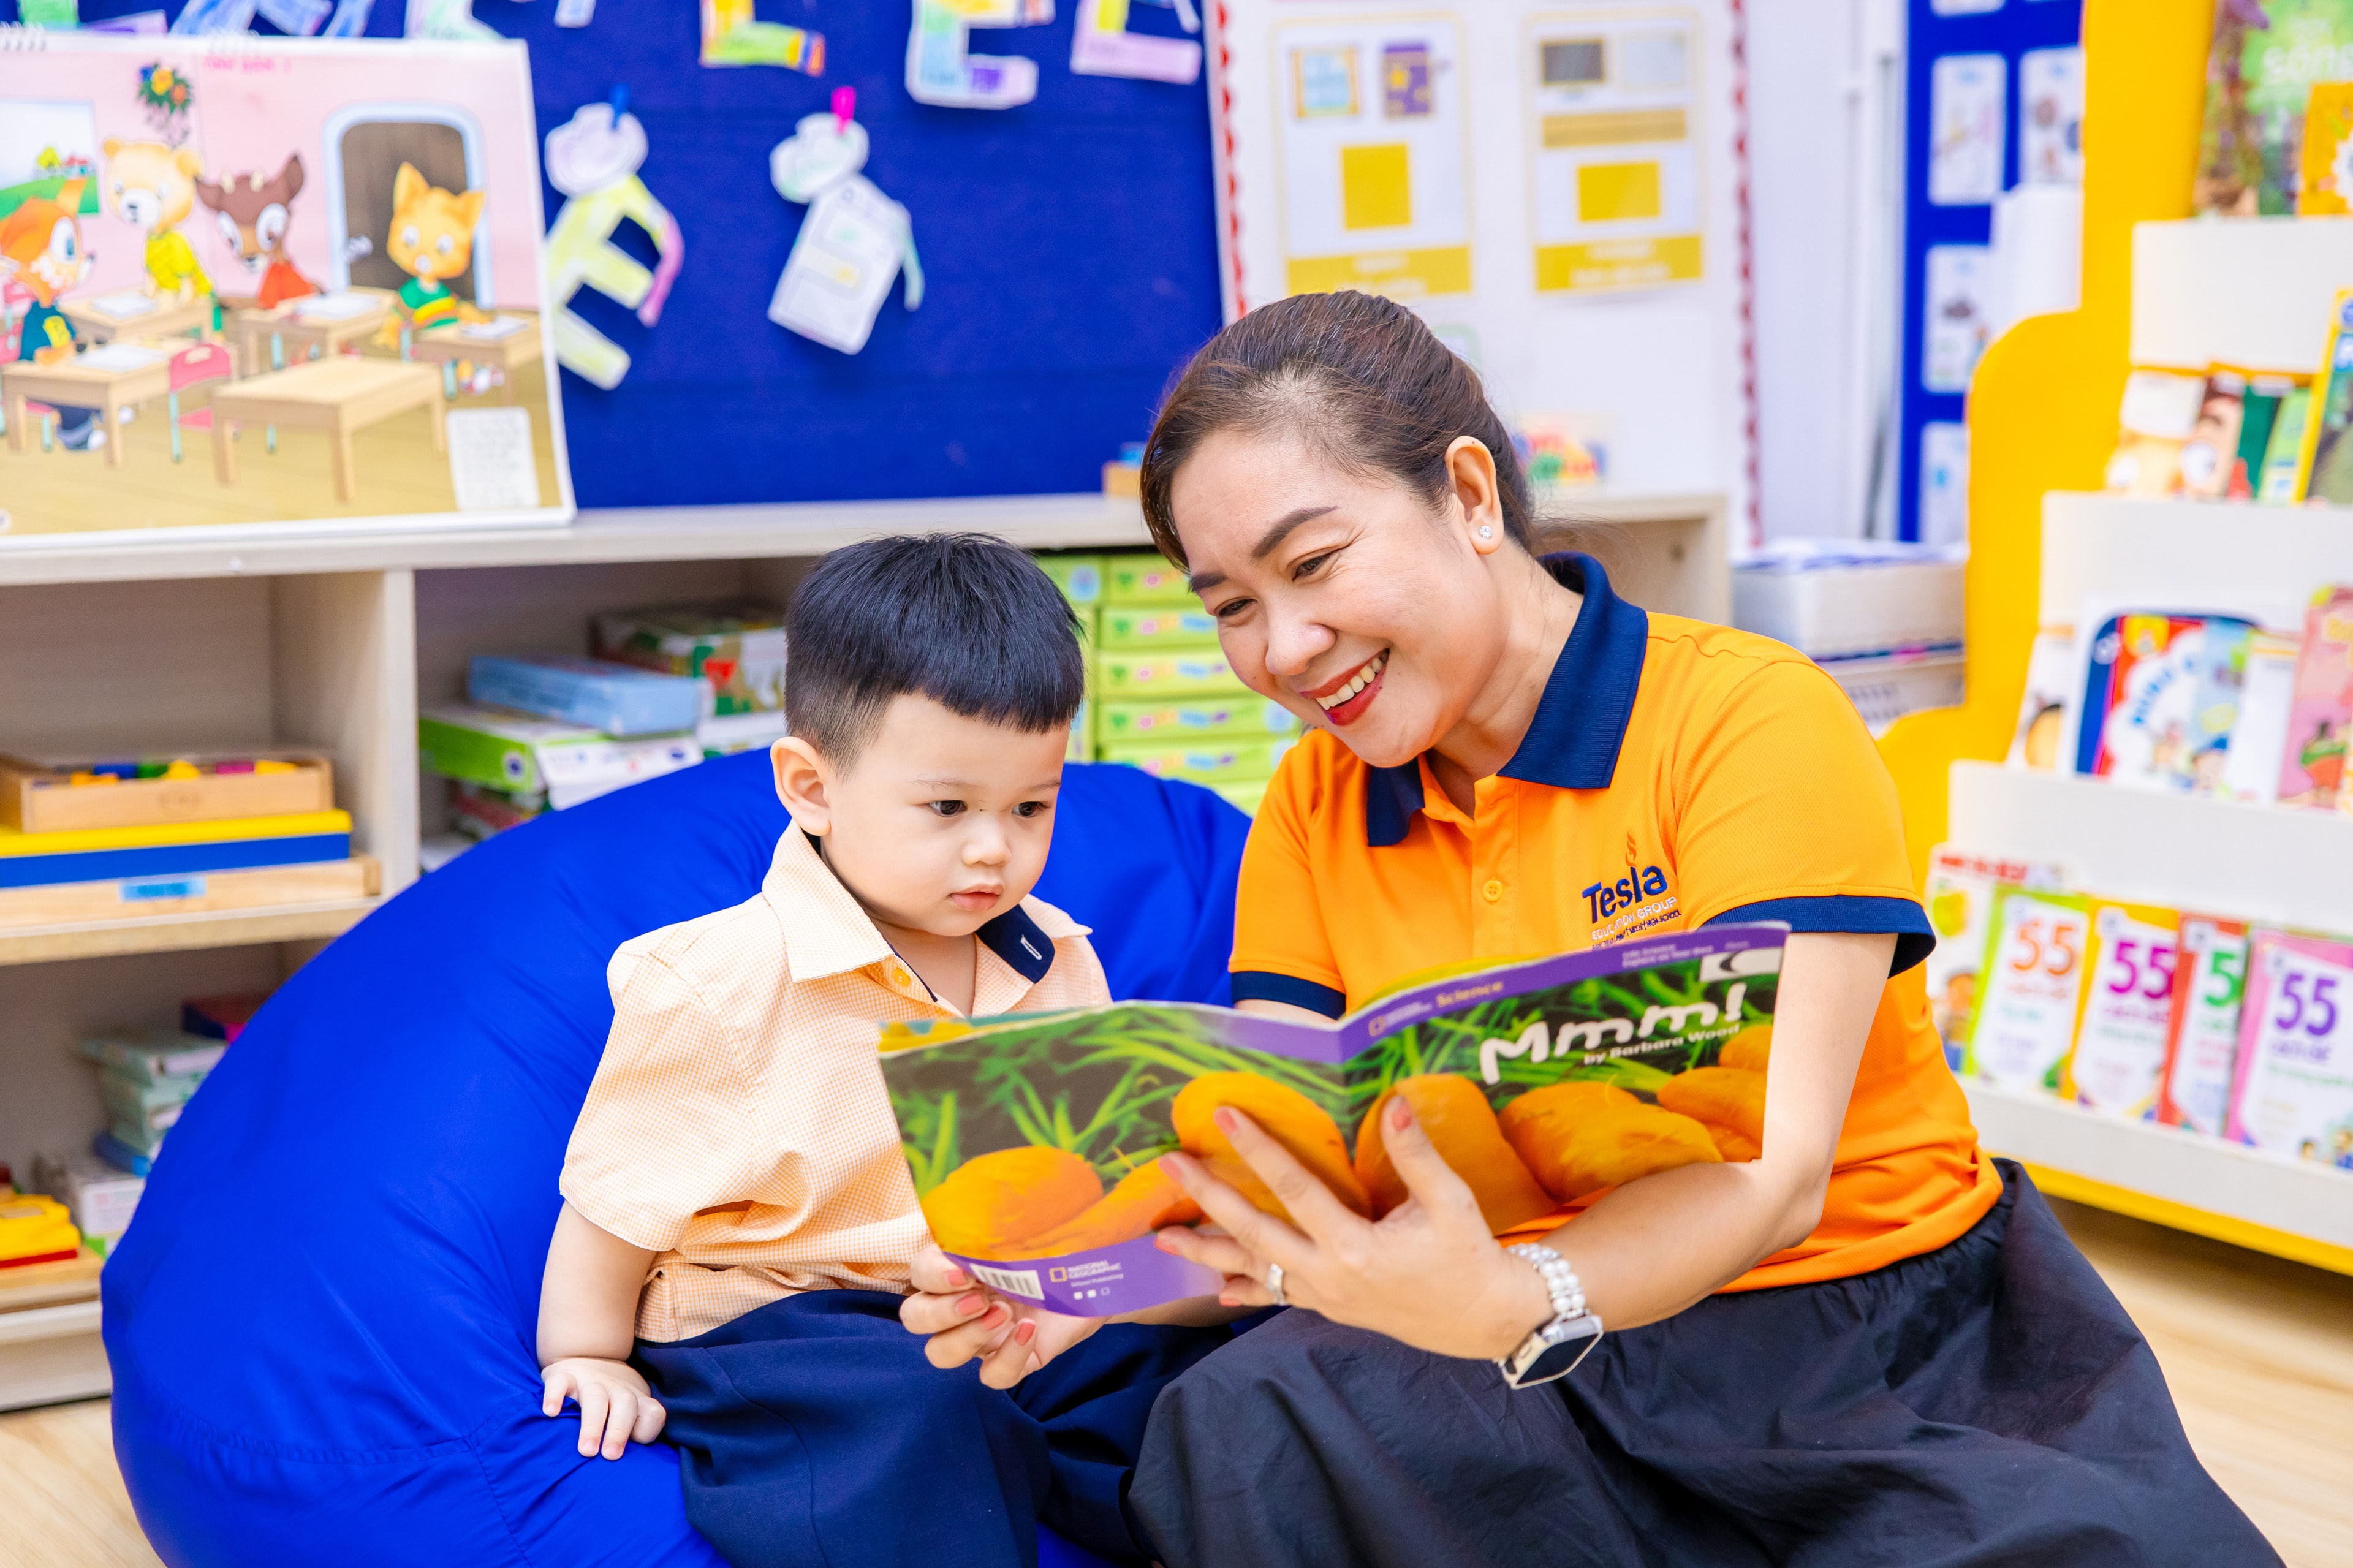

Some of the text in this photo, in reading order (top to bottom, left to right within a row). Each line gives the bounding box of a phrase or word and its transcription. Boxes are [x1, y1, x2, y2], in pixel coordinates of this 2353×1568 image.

[1582, 865, 1668, 924] Tesla
[1591, 912, 1635, 941] EDUCATION
[1636, 896, 1677, 919] GROUP
[2010, 918, 2076, 976] 55
[2107, 939, 2174, 1000] 55
[1436, 981, 1503, 1007] Science
[2275, 972, 2341, 1037] 55
[1480, 982, 1747, 1085] Mmm!
[1584, 1024, 1740, 1066] by Barbara Wood
[1068, 1260, 1108, 1272] NATIONAL
[1068, 1263, 1121, 1279] GEOGRAPHIC
